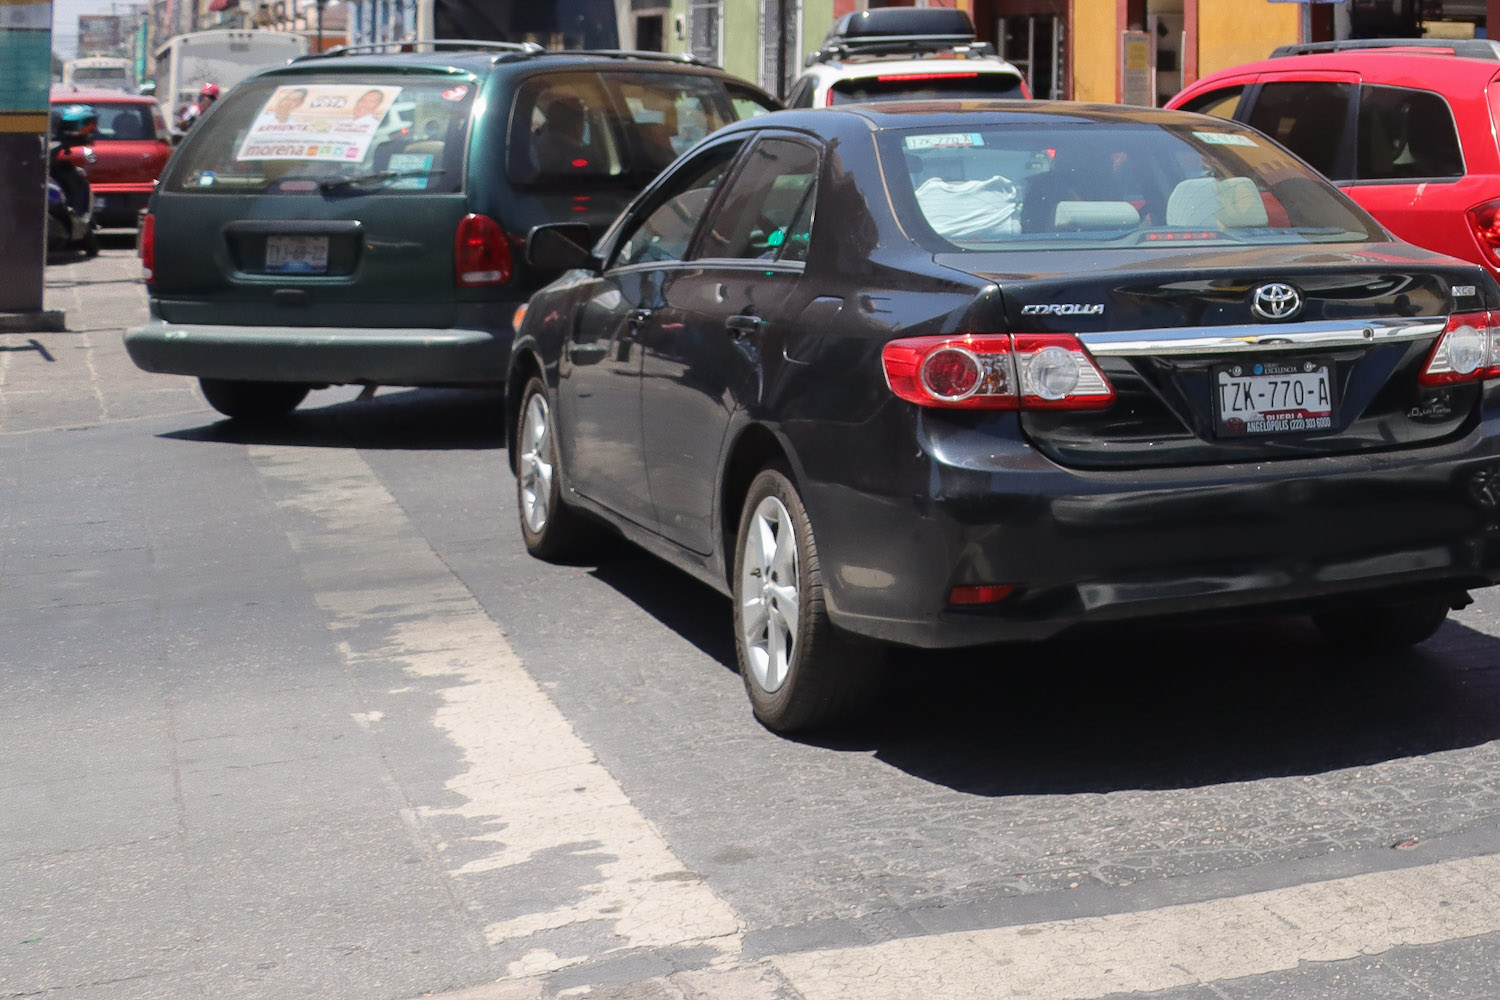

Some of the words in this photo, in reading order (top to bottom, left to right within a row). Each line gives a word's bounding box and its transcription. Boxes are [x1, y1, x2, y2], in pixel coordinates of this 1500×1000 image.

[245, 144, 305, 157] morena
[1021, 304, 1104, 316] COROLLA
[1264, 366, 1298, 375] EXCELENCIA
[1219, 378, 1329, 412] TZK-770-A
[1290, 418, 1305, 431] (222)
[1306, 418, 1316, 428] 303
[1316, 417, 1331, 428] 6000
